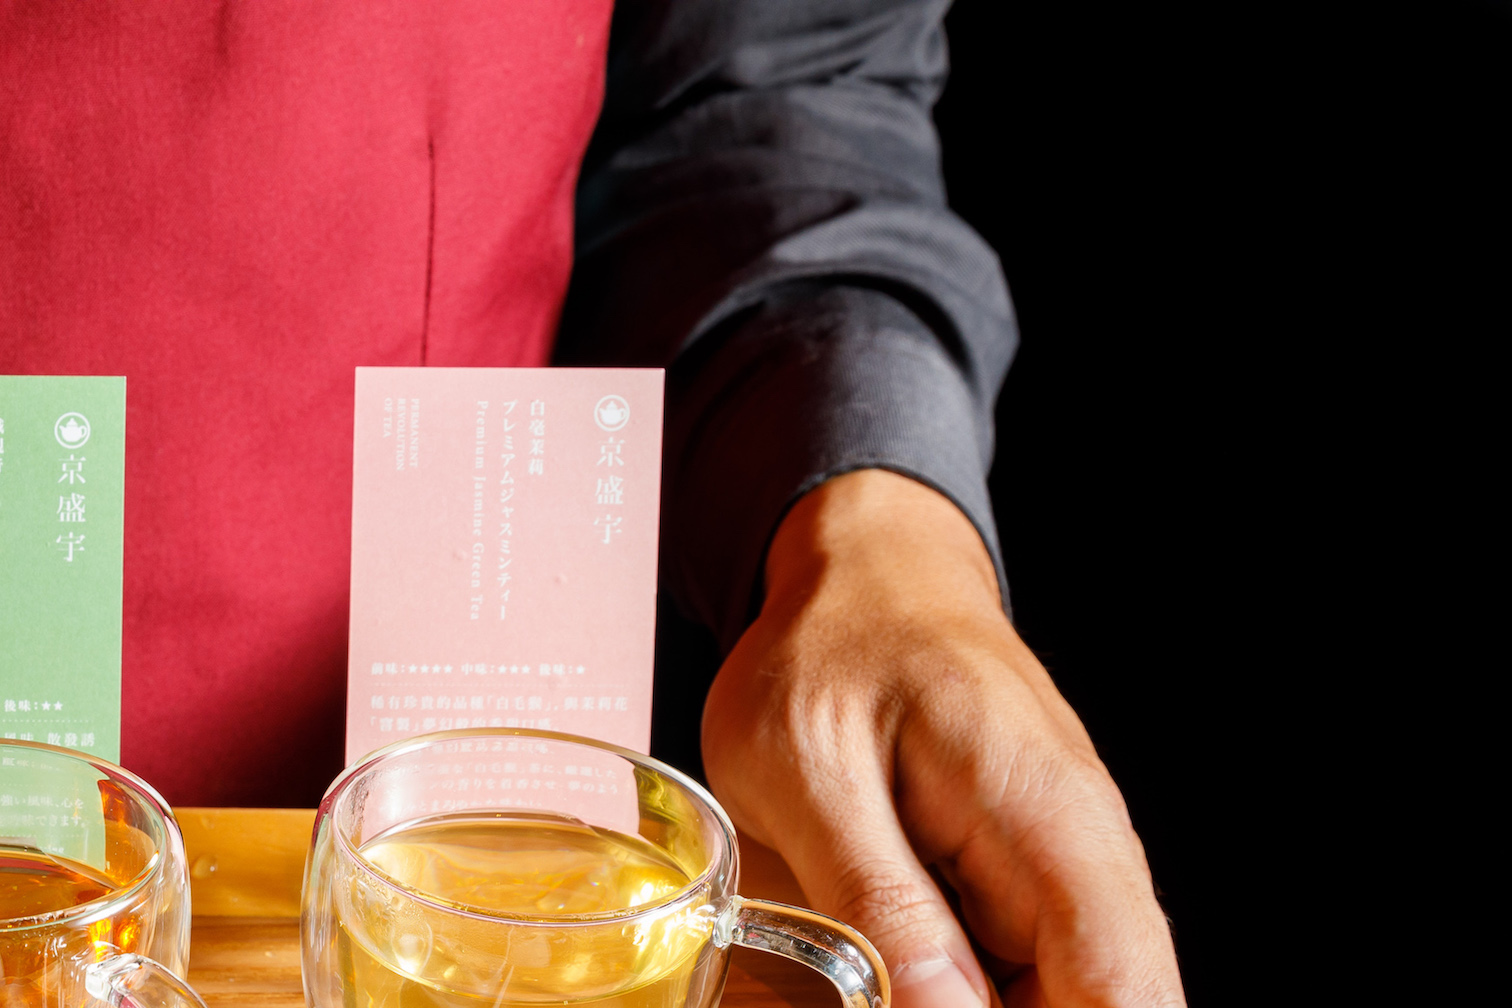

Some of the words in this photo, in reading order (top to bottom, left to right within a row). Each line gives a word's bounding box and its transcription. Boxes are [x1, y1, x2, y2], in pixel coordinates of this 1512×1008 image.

[383, 397, 393, 413] OF
[383, 416, 393, 438] TEA
[395, 397, 407, 471] REVOLUTION
[409, 398, 420, 467] PERMANENT
[475, 400, 489, 469] Premium
[527, 399, 545, 476] 白毫茉莉
[55, 453, 87, 563] 京盛宇
[472, 476, 487, 536] Jasmine
[496, 399, 518, 620] プレミアムジャスミンティー
[592, 436, 625, 545] 京盛宇
[471, 542, 485, 588] Green
[470, 594, 484, 620] Tea
